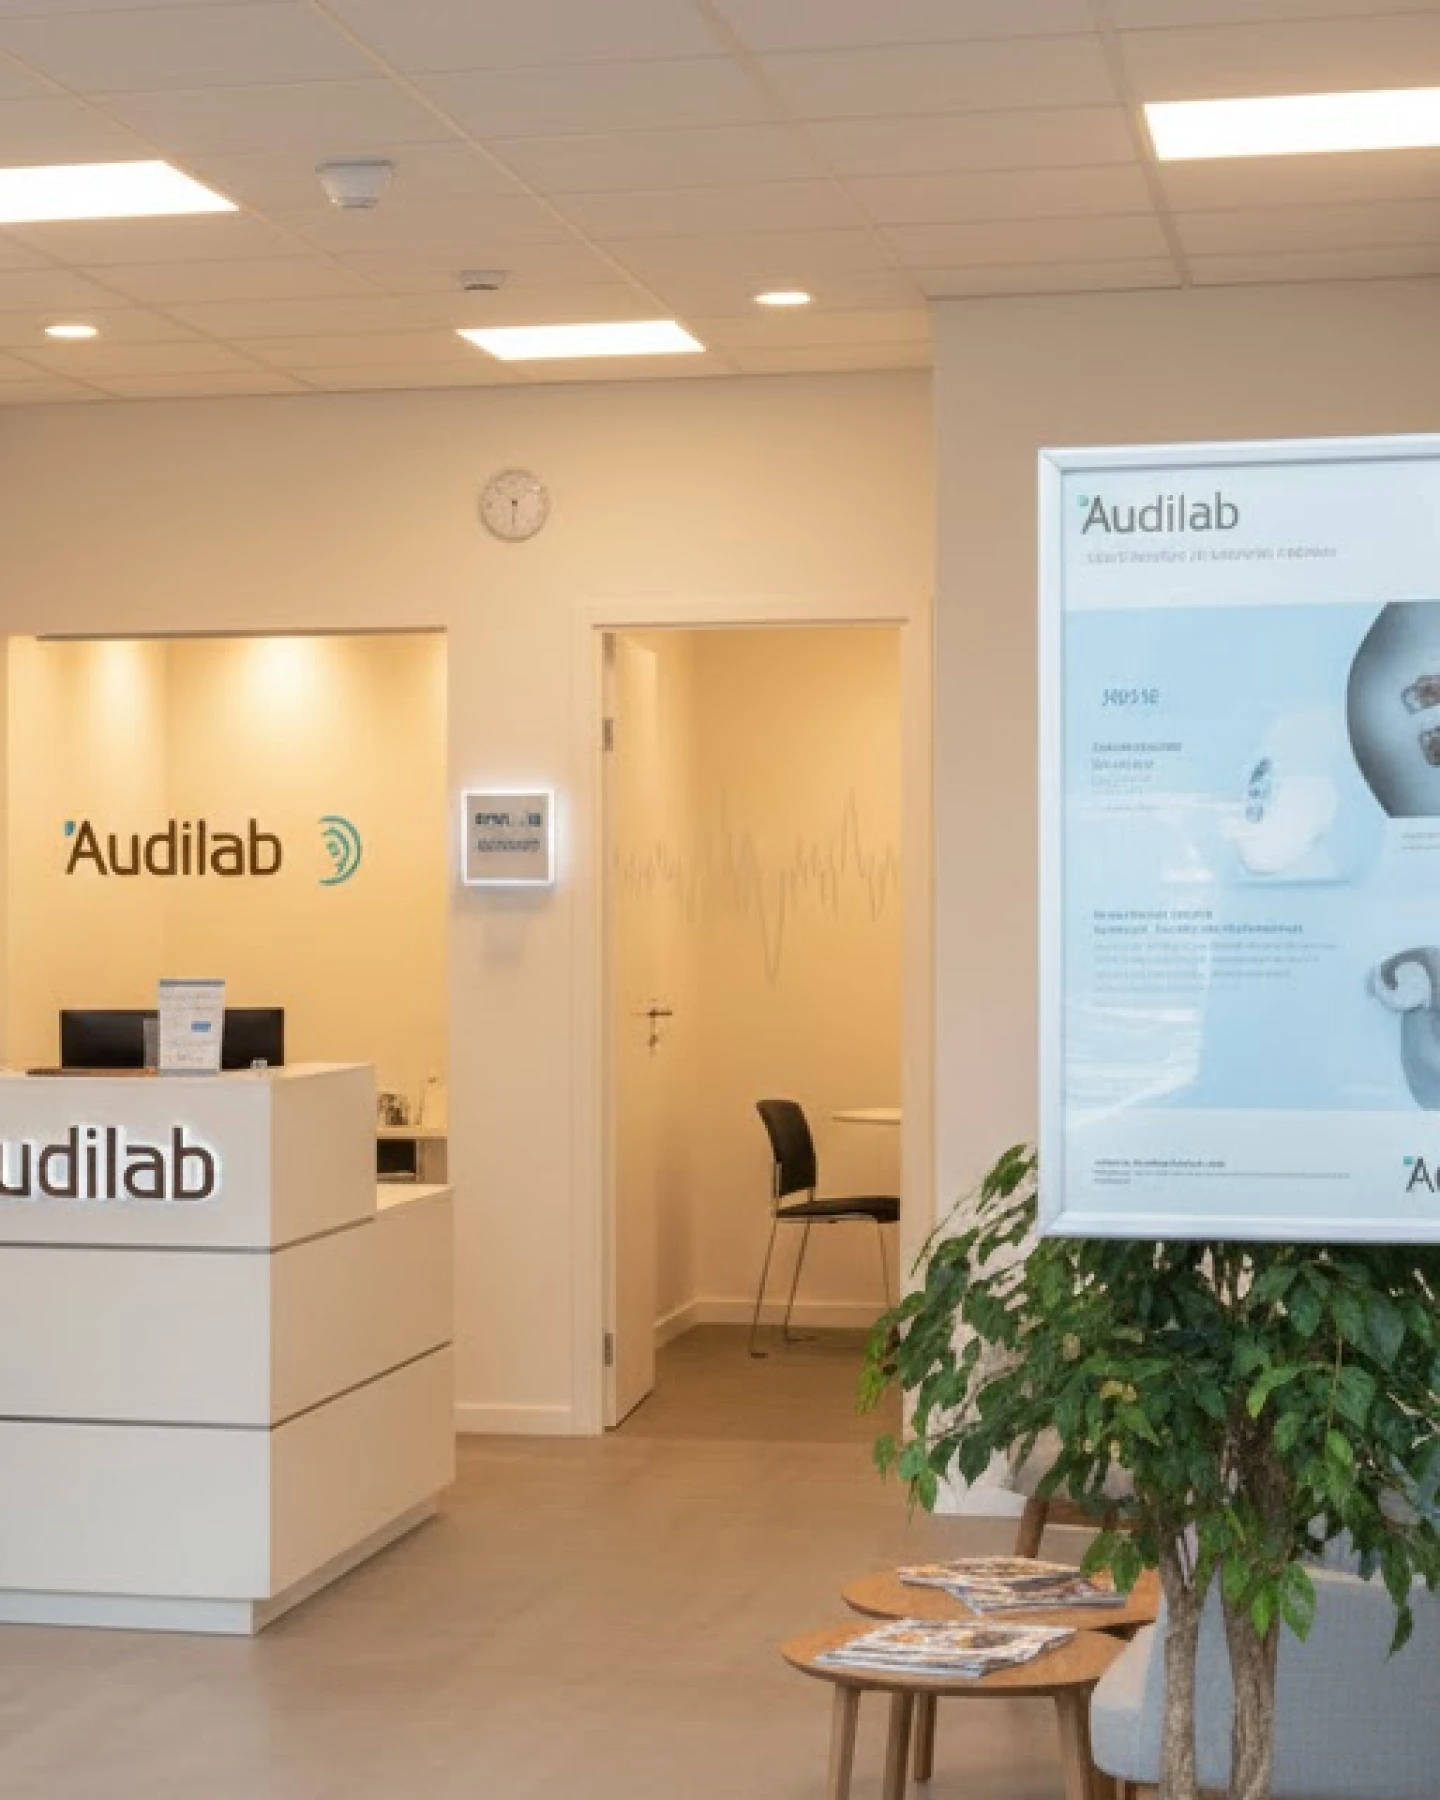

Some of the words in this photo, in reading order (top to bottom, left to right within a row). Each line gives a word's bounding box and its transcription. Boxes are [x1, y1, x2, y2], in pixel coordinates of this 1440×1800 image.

[1080, 491, 1240, 534] Audilab
[65, 818, 283, 876] Audilab
[1405, 1156, 1440, 1193] A
